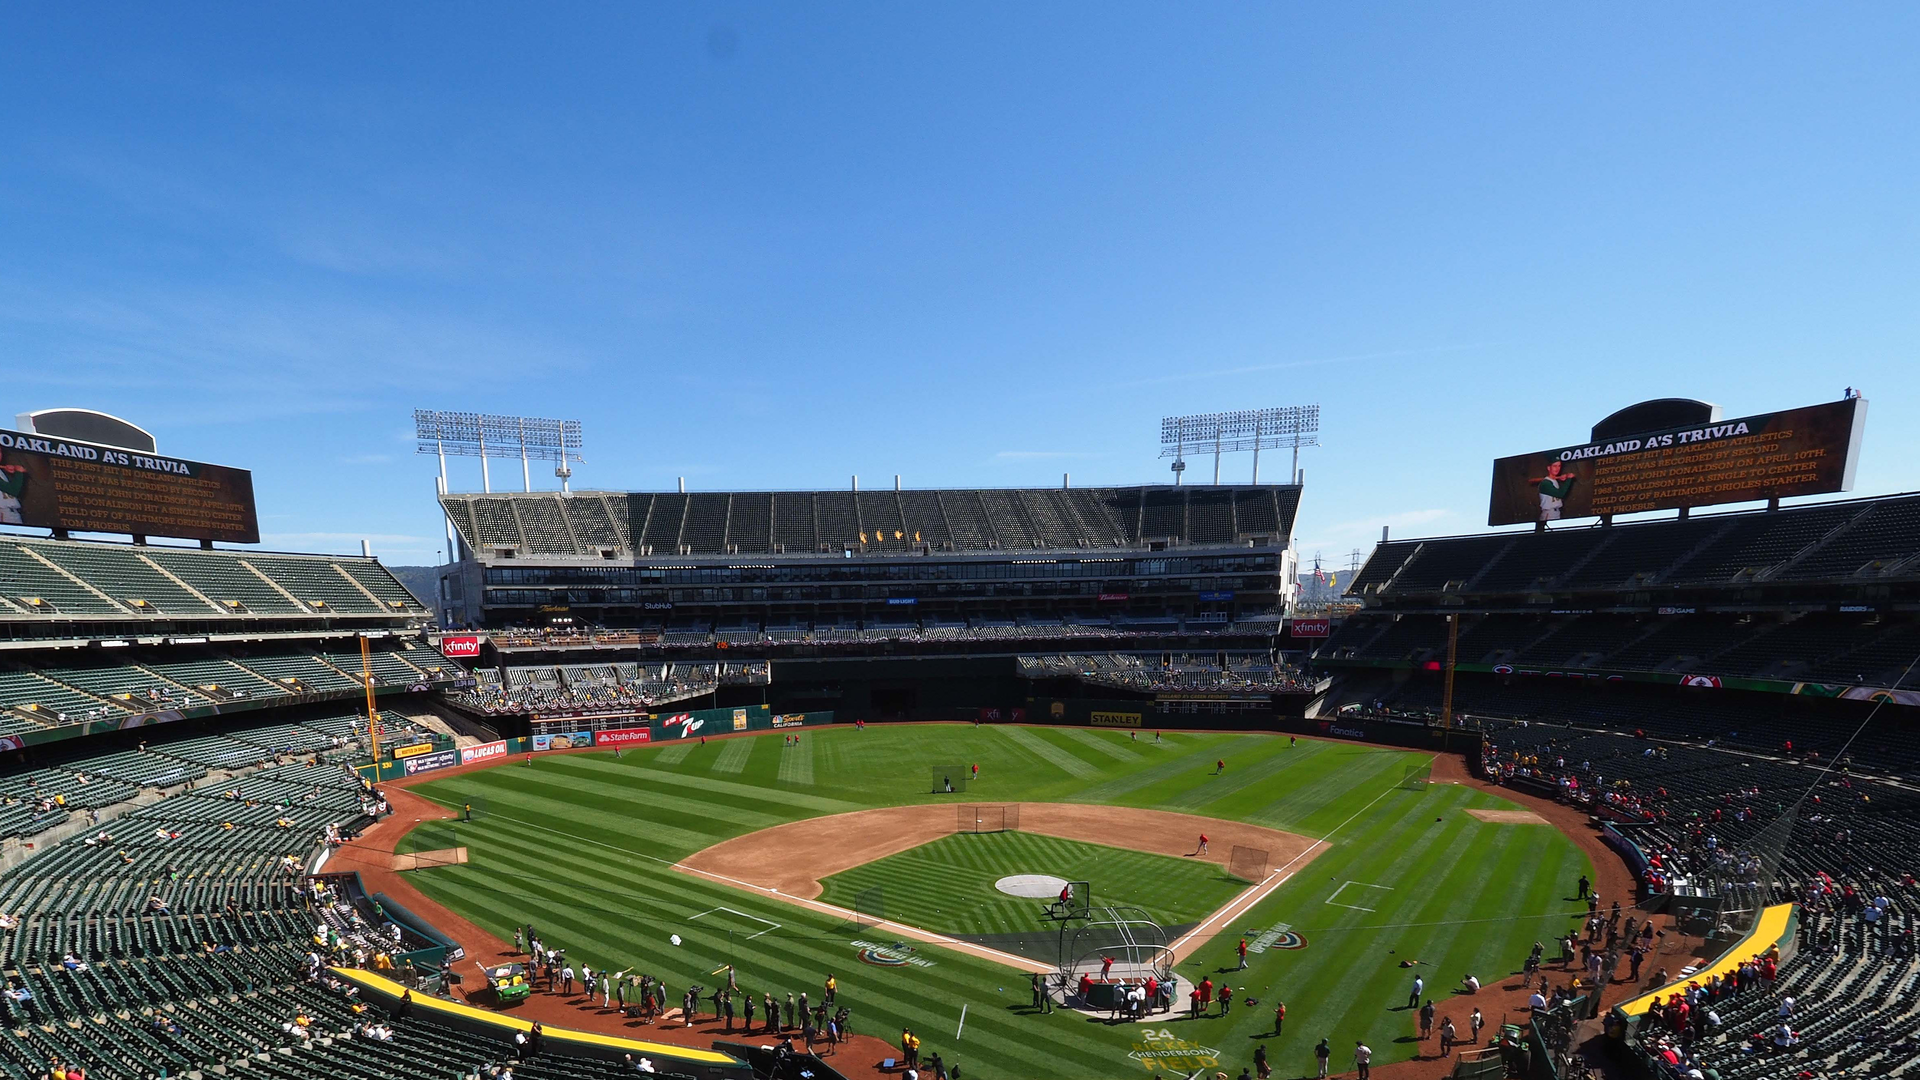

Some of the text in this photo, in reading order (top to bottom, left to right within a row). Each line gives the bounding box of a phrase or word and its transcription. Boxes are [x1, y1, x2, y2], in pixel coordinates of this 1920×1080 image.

[1560, 421, 1749, 461] OAKLAND A'S TRIVIA
[1596, 429, 1794, 466] THE FIRST HIT IN OAKLAND ATHLETICS
[0, 433, 191, 475] OAKLAND A'S TRIVIA
[1595, 443, 1778, 476] HISTORY WAS RECORDED BY SECOND
[50, 458, 221, 489] THE FIRST HIT IN OAKLAND ATHLETICS
[1594, 473, 1639, 486] BASEMAN
[1640, 468, 1666, 480] JOHN
[1669, 458, 1734, 477] DONALDSON
[1737, 458, 1754, 467] ON
[1756, 453, 1790, 466] APRIL
[1616, 476, 1673, 493] DONALDSON
[1677, 476, 1694, 484] HIT
[1697, 475, 1705, 484] A
[1707, 469, 1747, 483] SINGLE
[1749, 467, 1765, 477] TO
[1768, 461, 1817, 475] CENTER
[53, 470, 214, 498] HISTORY WAS RECORDED BY SECOND
[1592, 496, 1617, 505] FIELD
[1618, 493, 1637, 502] OFF
[1639, 491, 1651, 500] OF
[1653, 482, 1712, 499] BALTIMORE
[1714, 478, 1762, 492] ORIOLES
[55, 481, 104, 495] BASEMAN
[107, 489, 131, 500] JOHN
[133, 491, 187, 505] DONALDSON
[188, 499, 200, 507] ON
[202, 501, 224, 510] APRIL
[84, 496, 142, 512] DONALDSON
[144, 503, 159, 513] HIT
[161, 506, 168, 514] A
[169, 507, 198, 518] SINGLE
[200, 510, 212, 519] TO
[212, 512, 242, 522] CENTER
[1591, 505, 1611, 515] TOM
[59, 506, 88, 517] FIELD
[90, 509, 108, 519] OFF
[111, 512, 124, 520] OF
[126, 512, 175, 527] BALTIMORE
[177, 518, 210, 529] ORIOLES
[61, 518, 84, 529] TOM
[644, 602, 672, 610] StubHub
[1294, 621, 1328, 635] xfinity
[444, 637, 477, 653] xfinity
[773, 721, 804, 729] CALIFORNIA
[1092, 714, 1140, 725] STANLEY
[610, 730, 648, 742] State Farm
[1329, 725, 1364, 738] Fanatics
[474, 744, 505, 759] LUCAS OIL
[850, 940, 938, 968] OPENING DAY
[1141, 1028, 1175, 1041] 24
[1131, 1040, 1200, 1052] RICKEY
[1136, 1048, 1211, 1058] HENDERSON
[1140, 1055, 1219, 1071] FIELD
